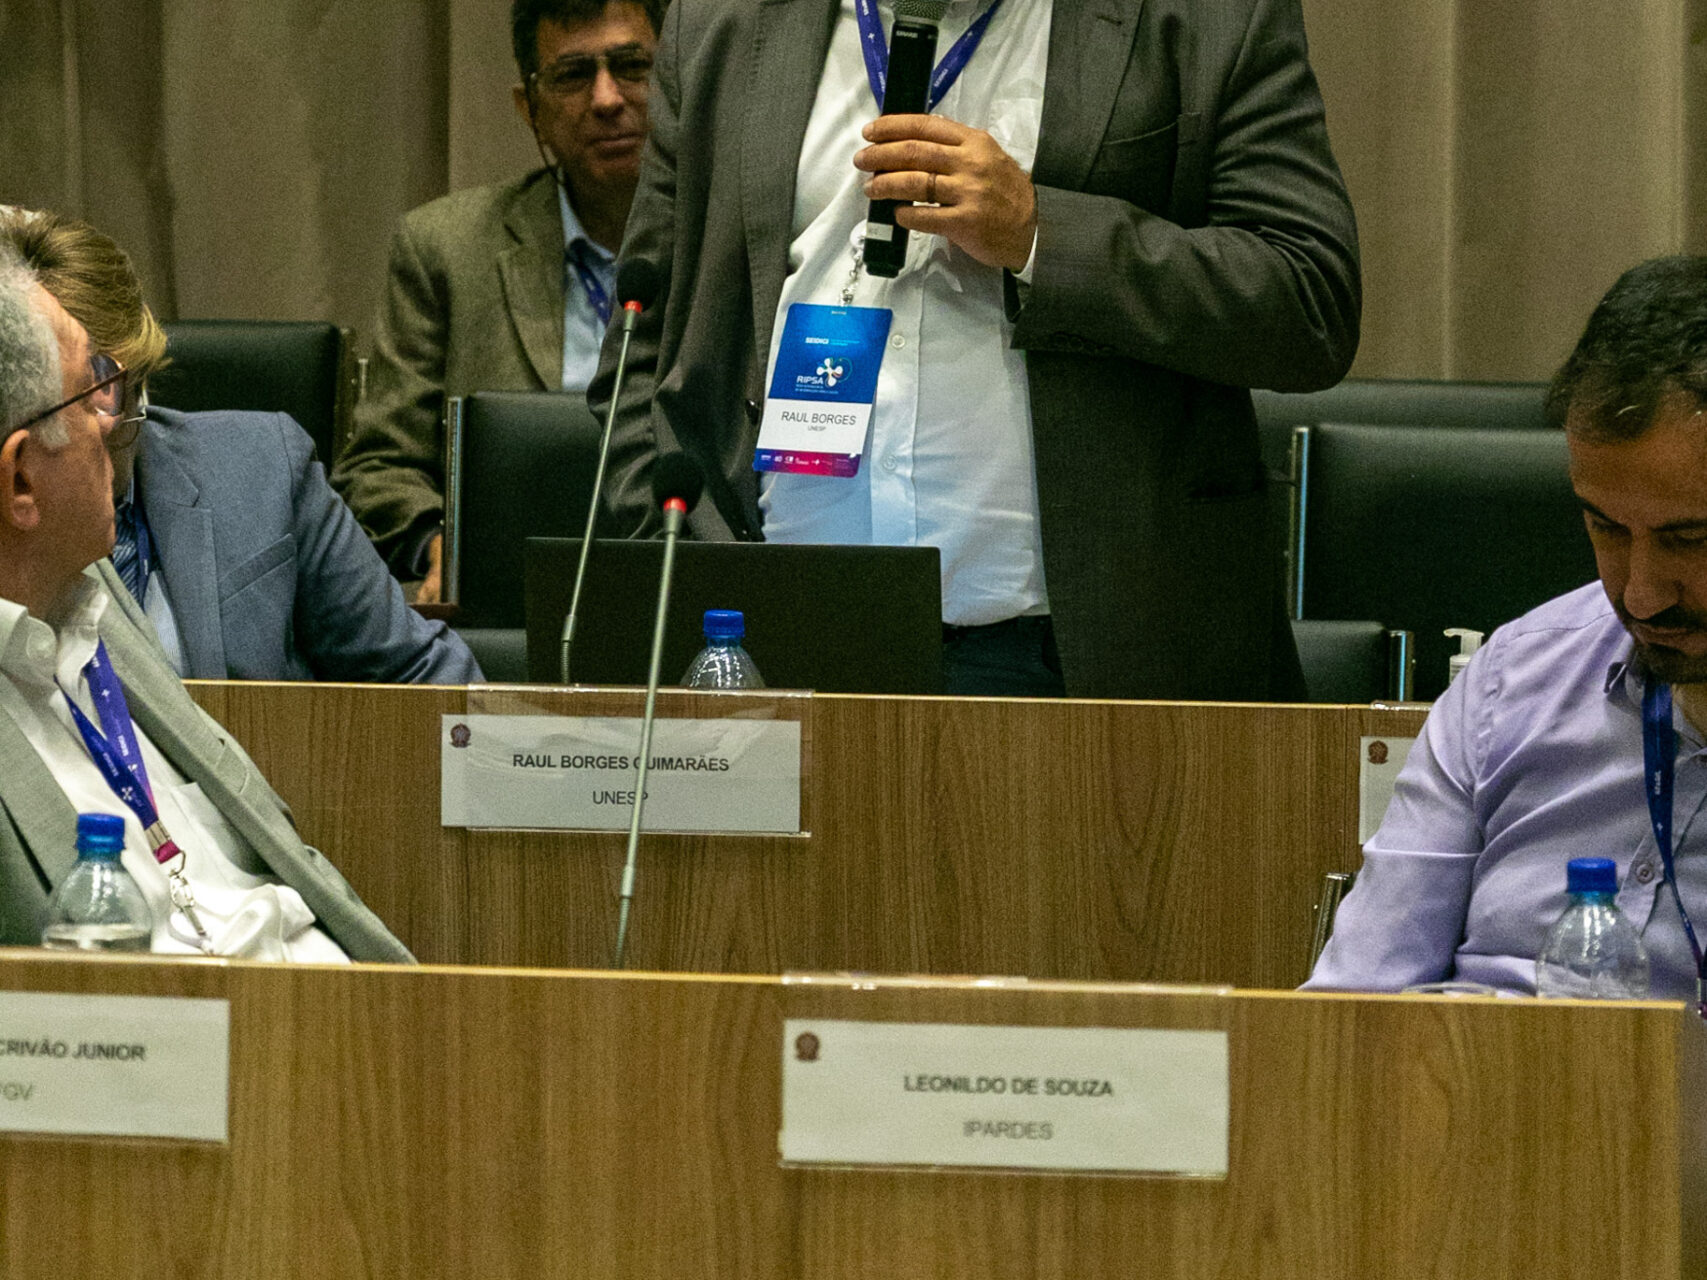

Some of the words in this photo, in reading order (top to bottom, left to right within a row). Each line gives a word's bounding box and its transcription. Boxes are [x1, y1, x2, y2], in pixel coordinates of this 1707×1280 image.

[796, 375, 824, 385] RIPSA
[781, 411, 809, 423] RAUL
[811, 413, 857, 425] BORGES
[512, 753, 557, 769] RAUL
[560, 754, 630, 770] BORGES
[73, 1043, 146, 1061] JUNIOR
[903, 1075, 1006, 1094] LEONILDO
[1012, 1077, 1038, 1095] DE
[1045, 1079, 1113, 1097] SOUZA
[963, 1120, 1053, 1140] IPARDES
